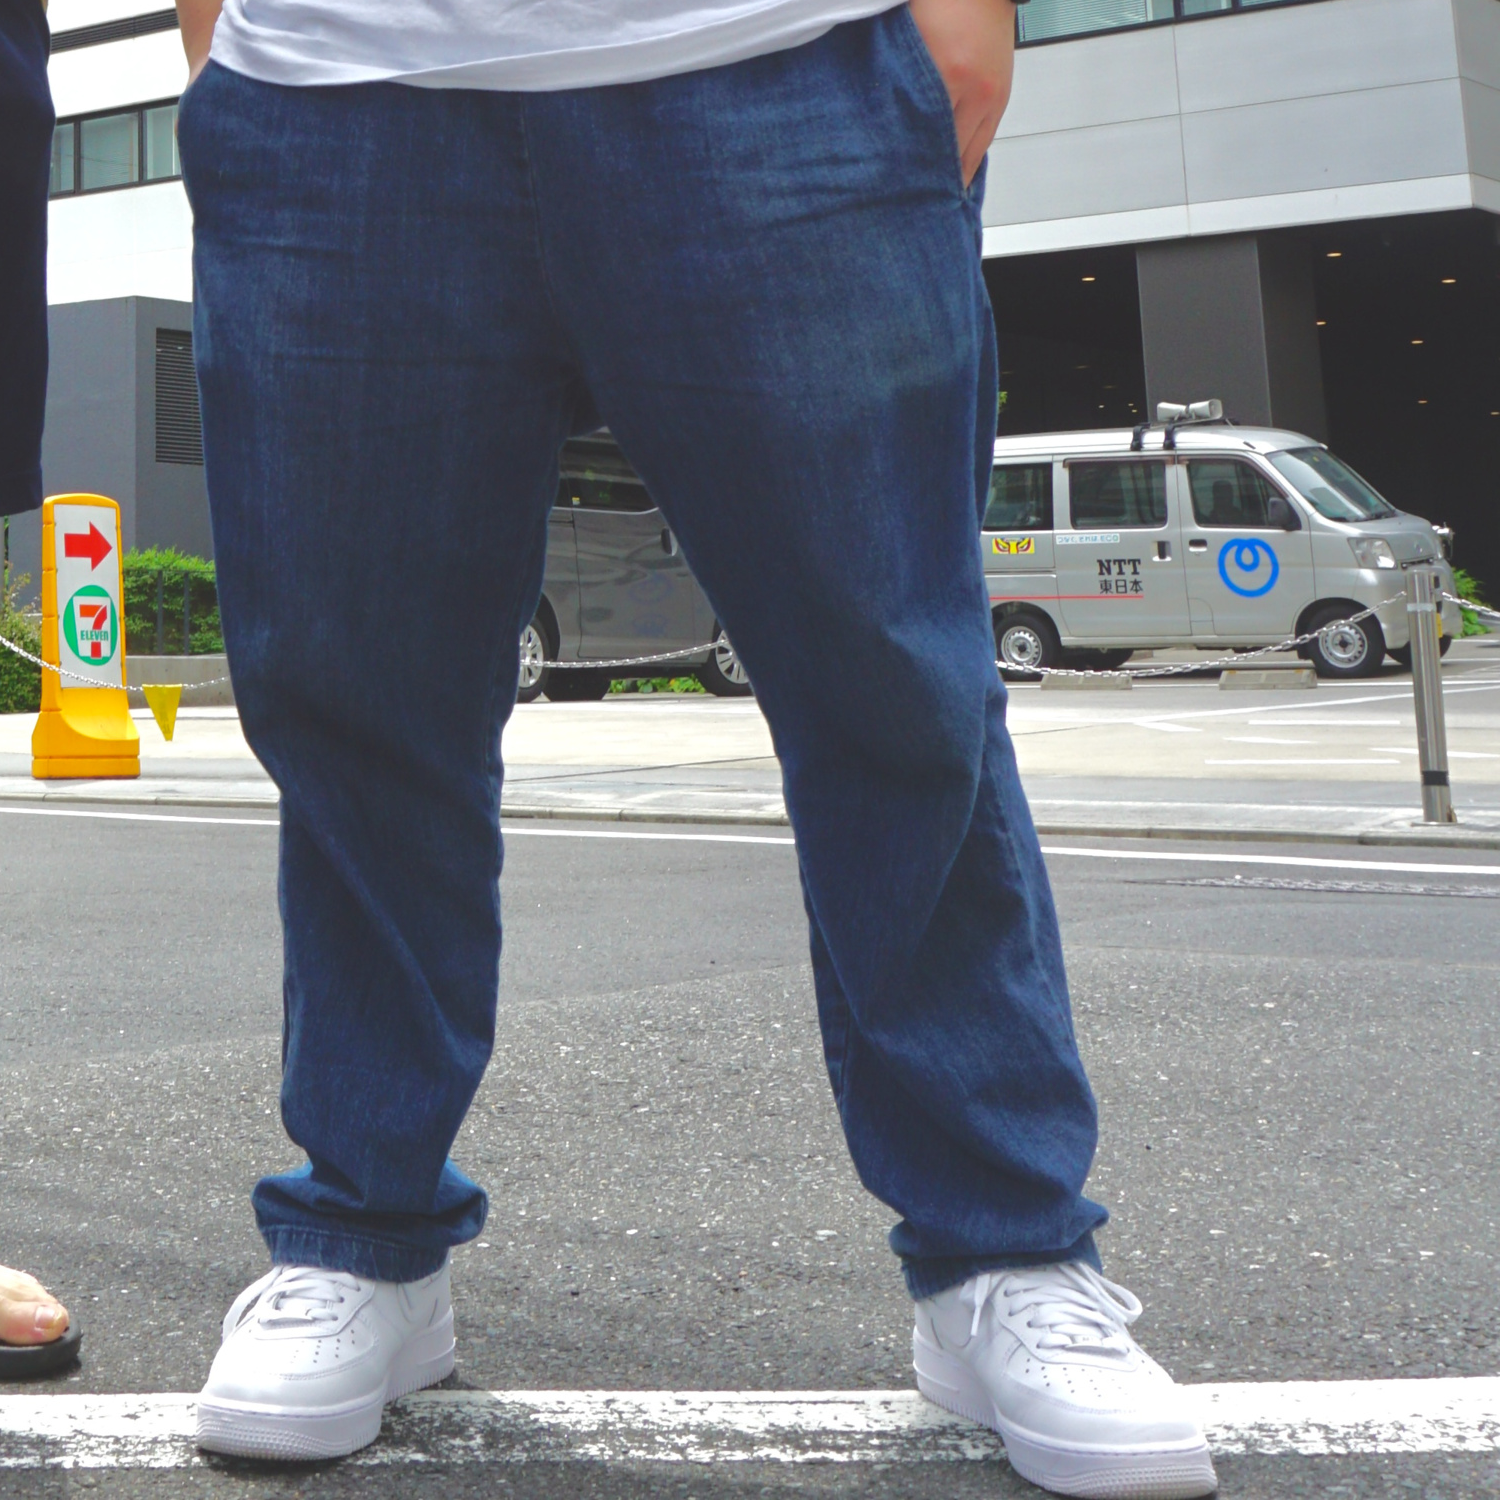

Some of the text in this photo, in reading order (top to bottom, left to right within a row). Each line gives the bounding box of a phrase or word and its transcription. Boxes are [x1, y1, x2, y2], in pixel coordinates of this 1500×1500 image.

[1097, 558, 1141, 575] NTT
[1099, 579, 1143, 594] 東日本
